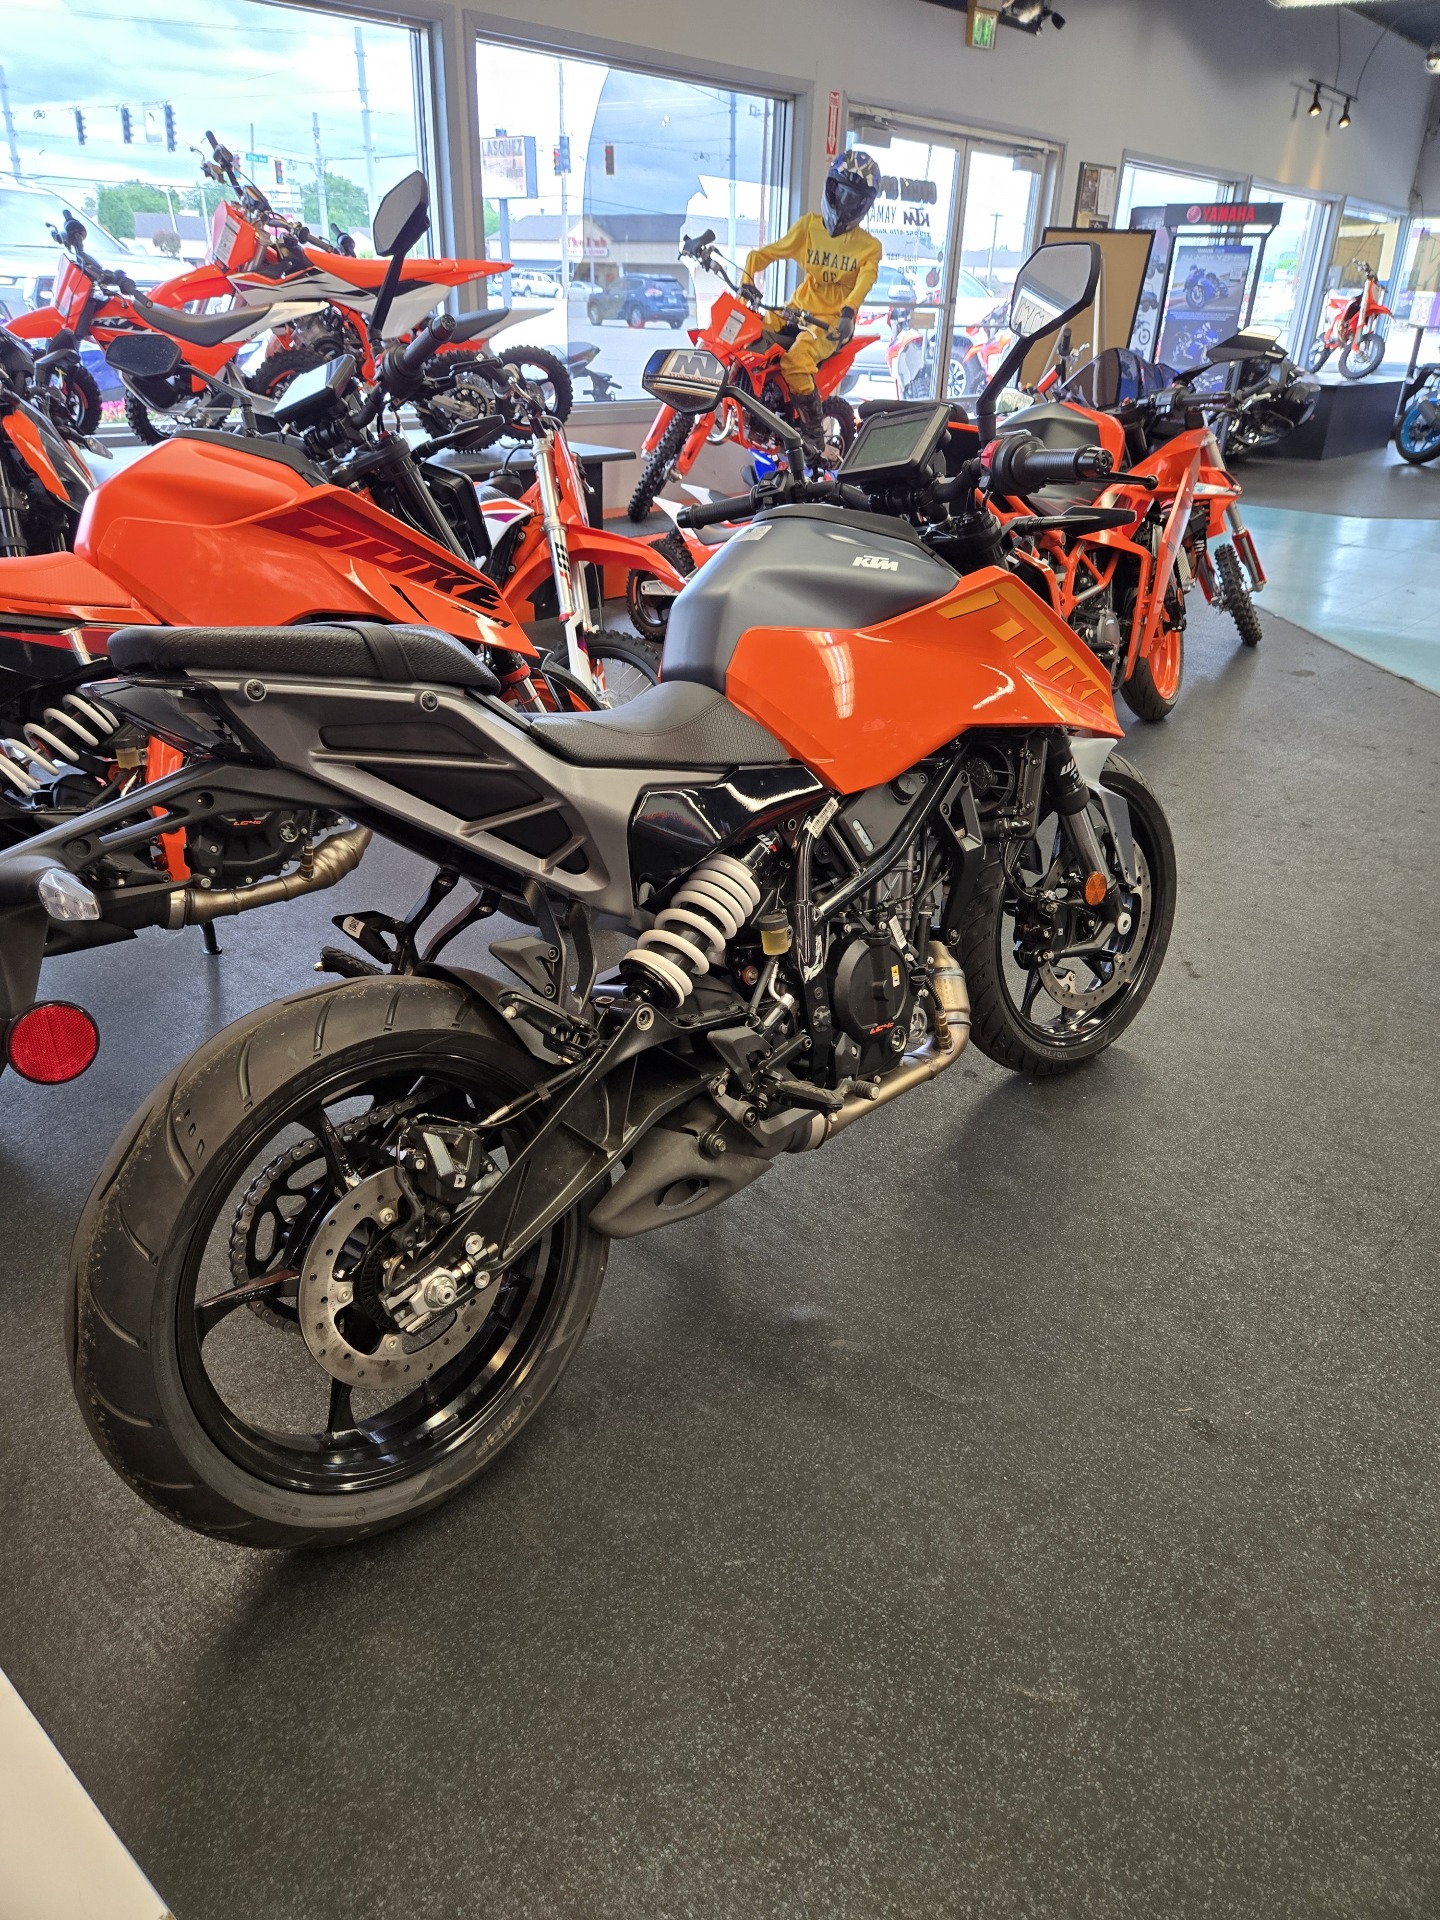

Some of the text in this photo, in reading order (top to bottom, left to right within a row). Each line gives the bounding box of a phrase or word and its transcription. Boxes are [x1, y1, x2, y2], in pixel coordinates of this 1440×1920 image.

[1203, 205, 1255, 222] YAMAHA
[807, 248, 857, 271] YAMAHA
[251, 508, 503, 611] DUKE
[852, 554, 899, 572] KTM
